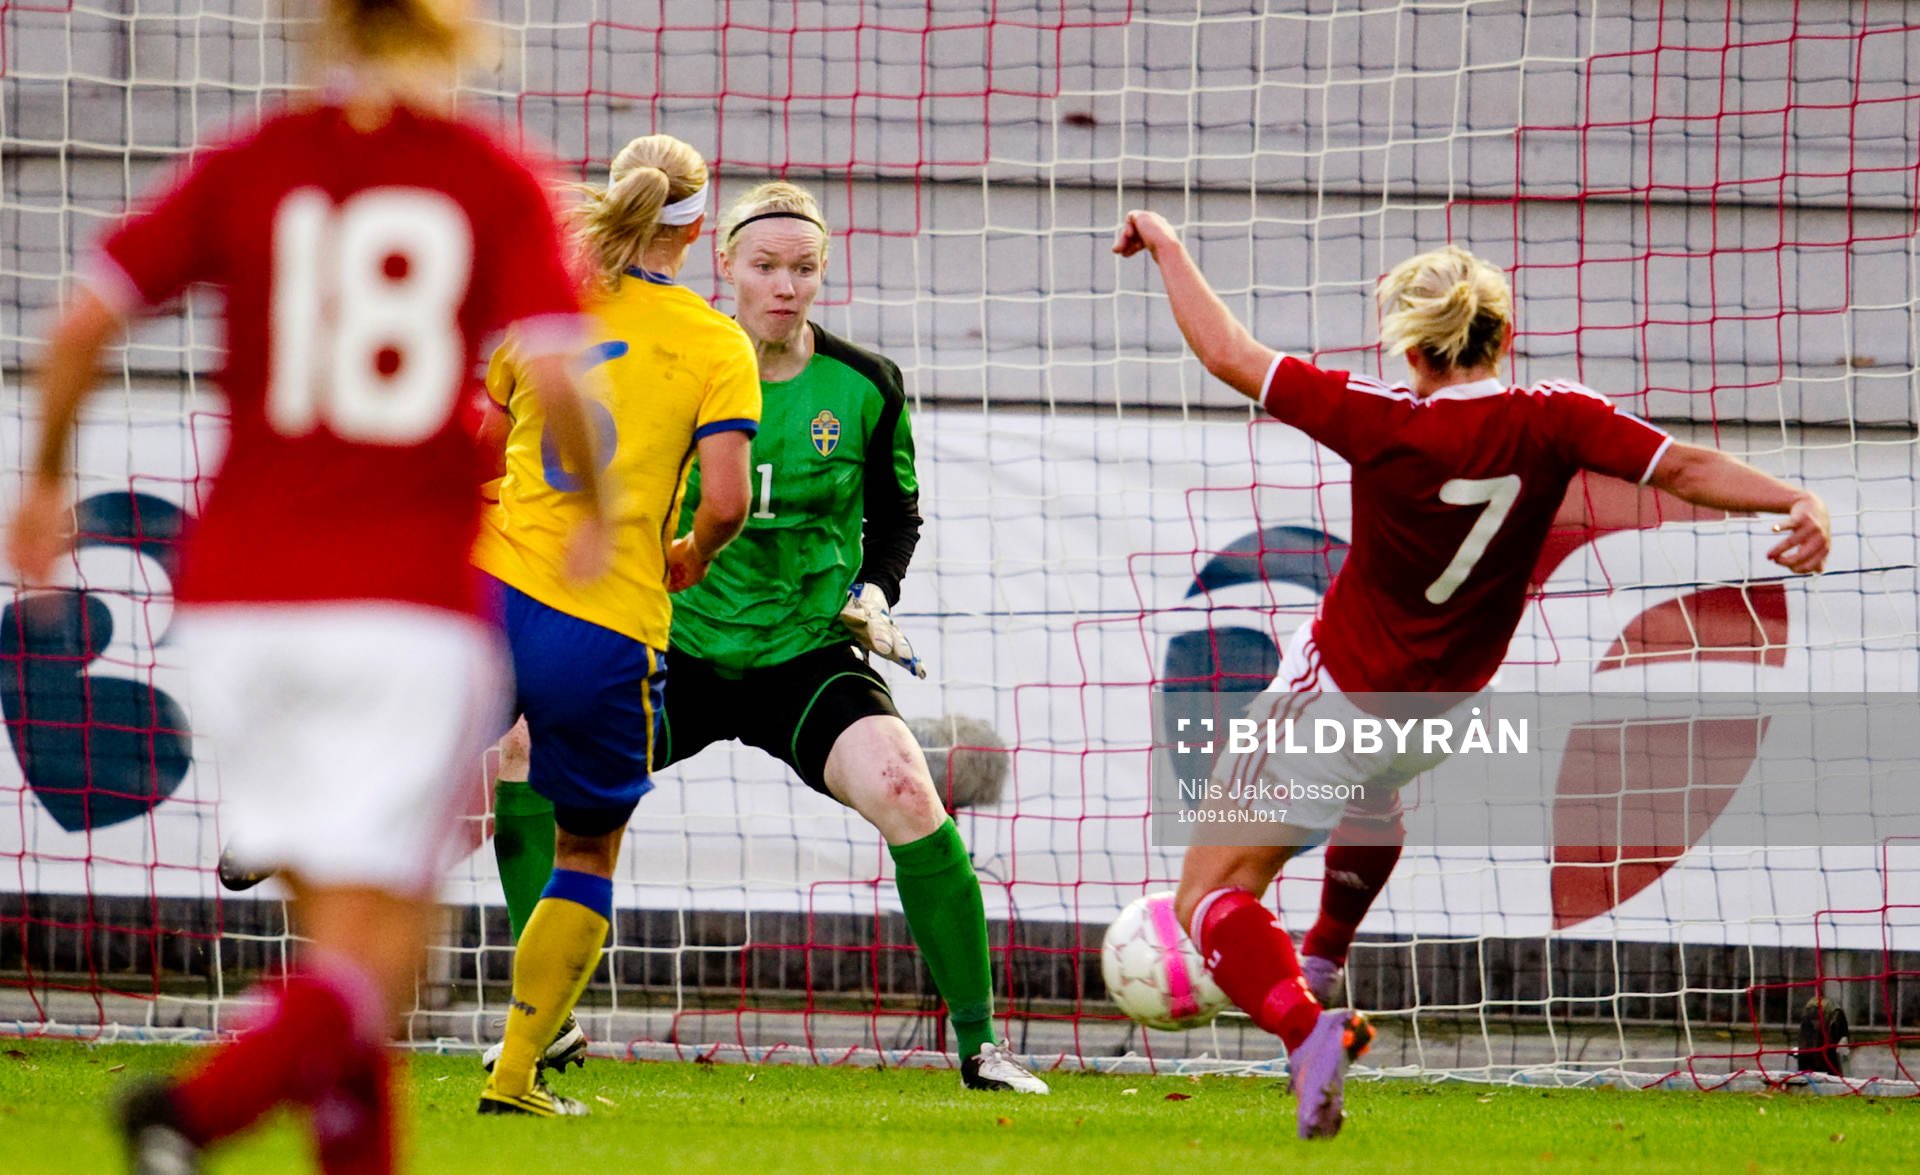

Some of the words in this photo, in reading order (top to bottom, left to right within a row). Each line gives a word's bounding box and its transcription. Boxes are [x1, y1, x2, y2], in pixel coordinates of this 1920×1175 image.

[265, 185, 474, 446] 18
[753, 463, 776, 519] 1
[1424, 474, 1521, 604] 7
